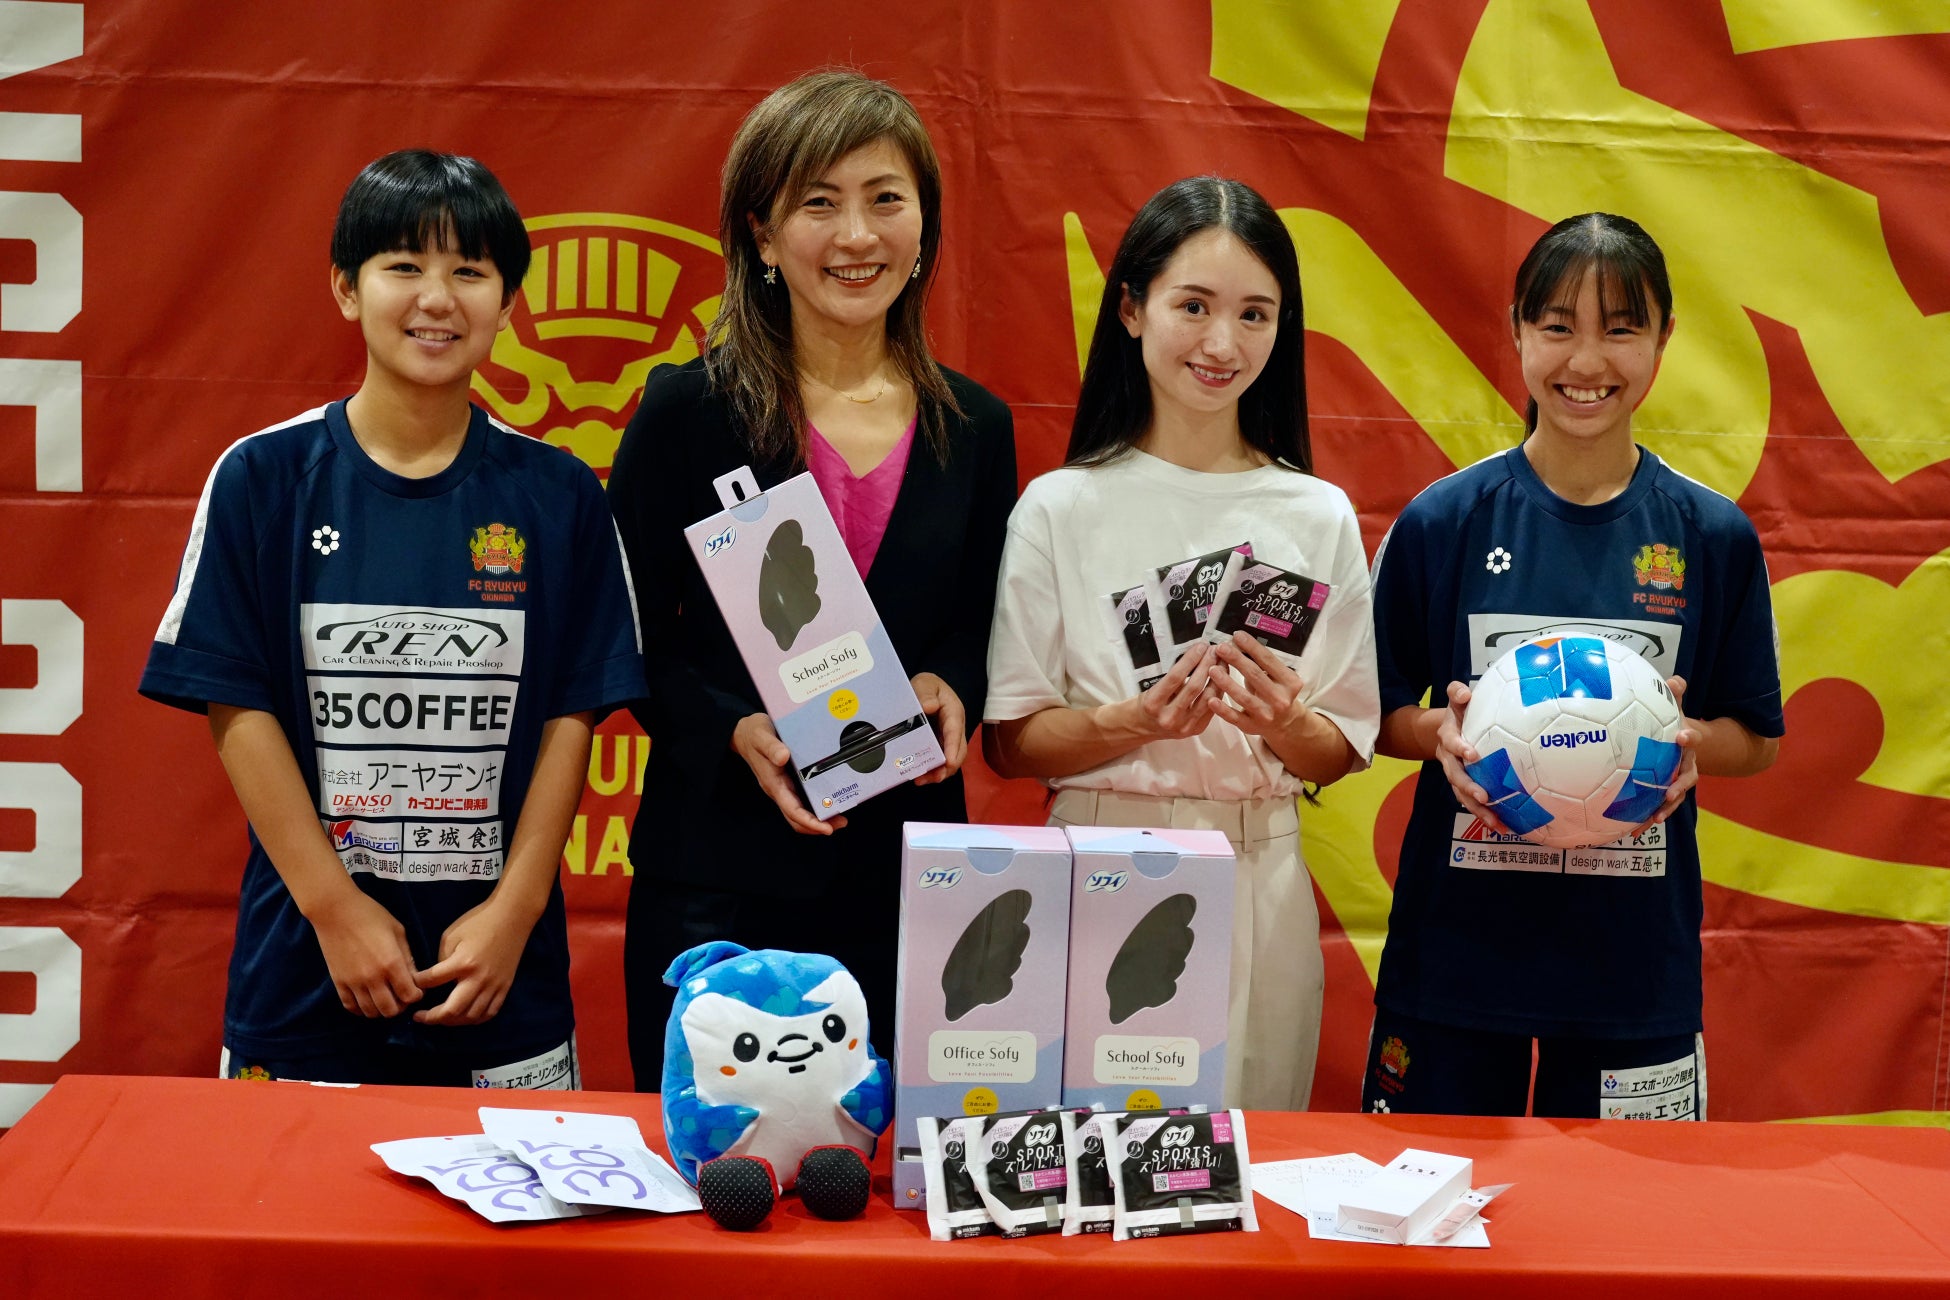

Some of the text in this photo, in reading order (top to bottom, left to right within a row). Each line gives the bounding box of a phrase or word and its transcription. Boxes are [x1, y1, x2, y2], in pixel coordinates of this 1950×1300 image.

[469, 580, 527, 592] FC RYUKYU
[482, 593, 515, 602] OKINAWA
[1255, 593, 1303, 616] SPORTS
[1633, 593, 1686, 608] FC RYUKYU
[1645, 605, 1676, 616] OKINAWA
[368, 621, 470, 631] AUTO SHOP
[341, 630, 489, 658] REN
[401, 657, 411, 666] &
[792, 647, 858, 684] School Sofy
[313, 690, 512, 731] 35COFFEE
[1540, 729, 1607, 749] molten
[367, 762, 497, 793] アニヤデンキ
[333, 794, 392, 807] DENSO
[1477, 850, 1560, 866] 長光電気空調設備
[1571, 855, 1604, 871] design
[1606, 857, 1629, 869] wark
[408, 861, 442, 877] design
[444, 861, 469, 874] wark
[943, 1046, 1019, 1063] Office Sofy
[1107, 1049, 1185, 1068] School Sofy
[1152, 1145, 1211, 1162] SPORTS
